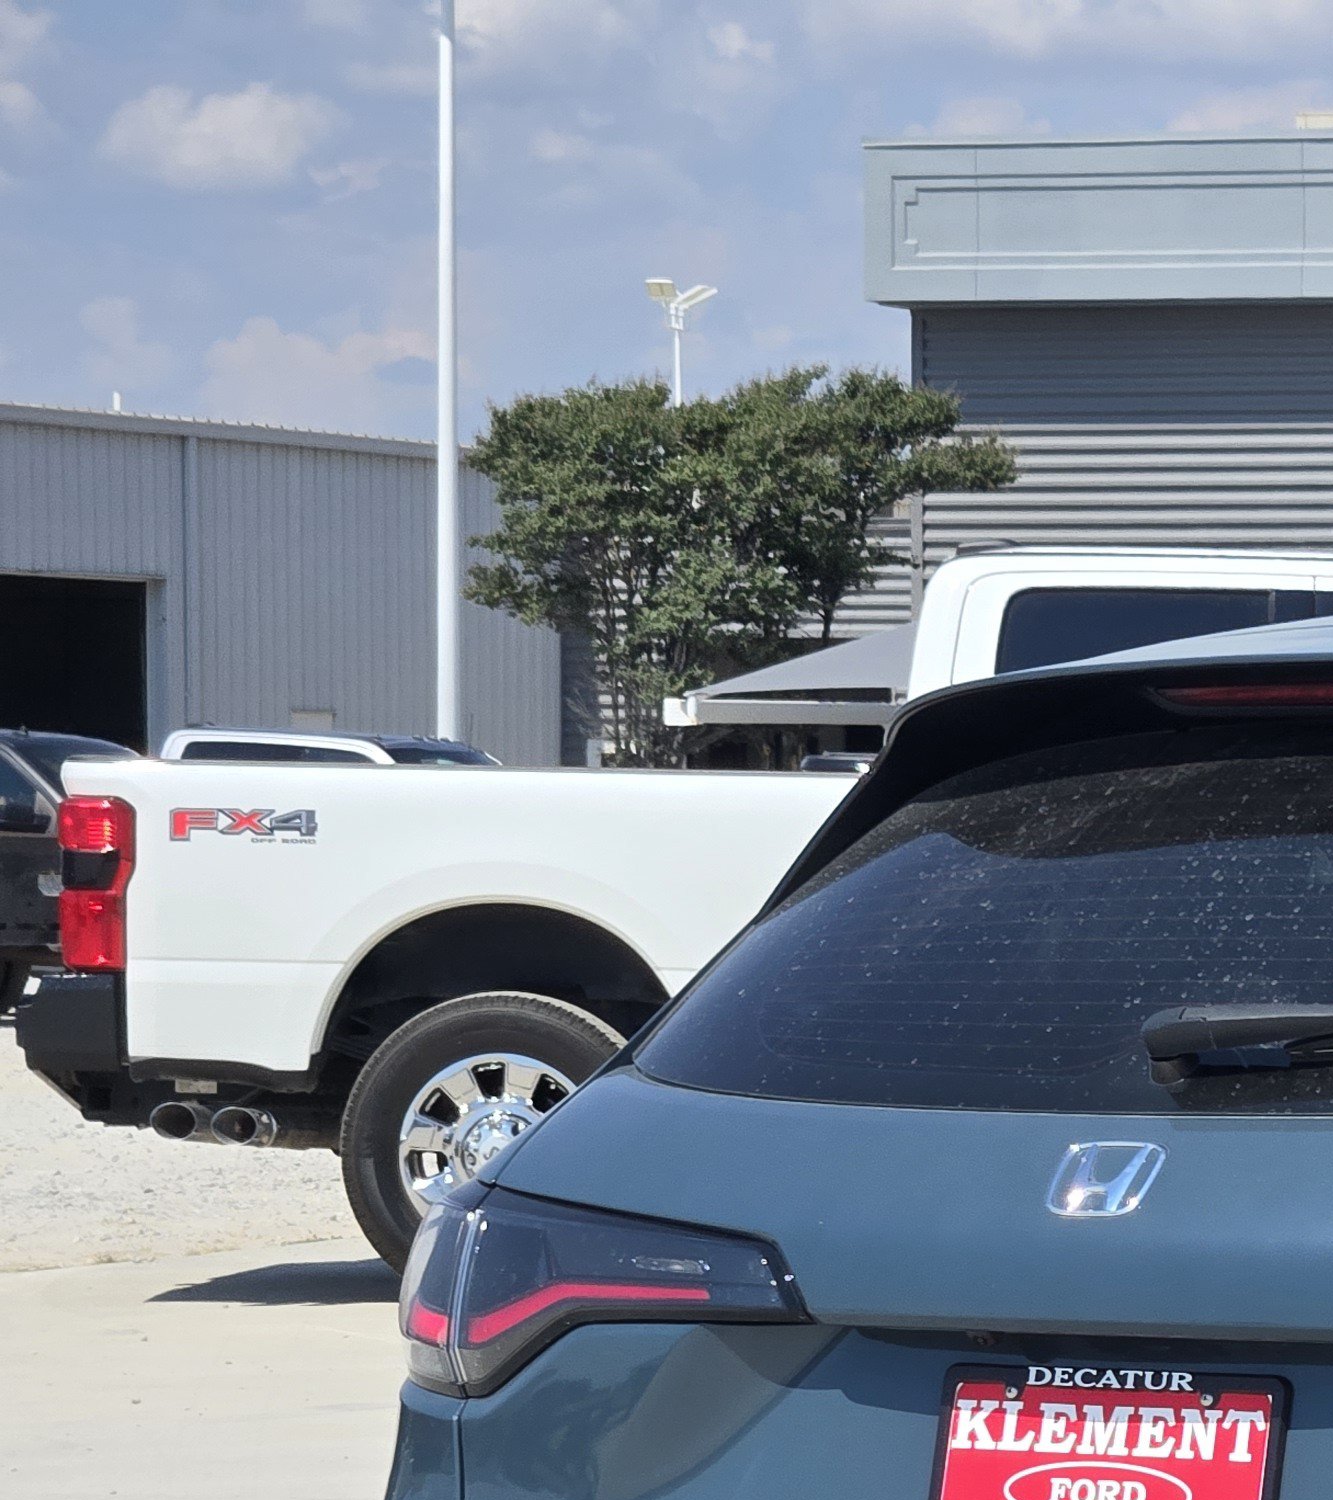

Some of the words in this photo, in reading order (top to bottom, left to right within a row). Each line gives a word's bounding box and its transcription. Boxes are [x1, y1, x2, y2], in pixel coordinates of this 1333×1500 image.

[169, 806, 318, 842] FX4
[1026, 1366, 1193, 1391] DECATUR
[951, 1399, 1267, 1463] KLEMENT
